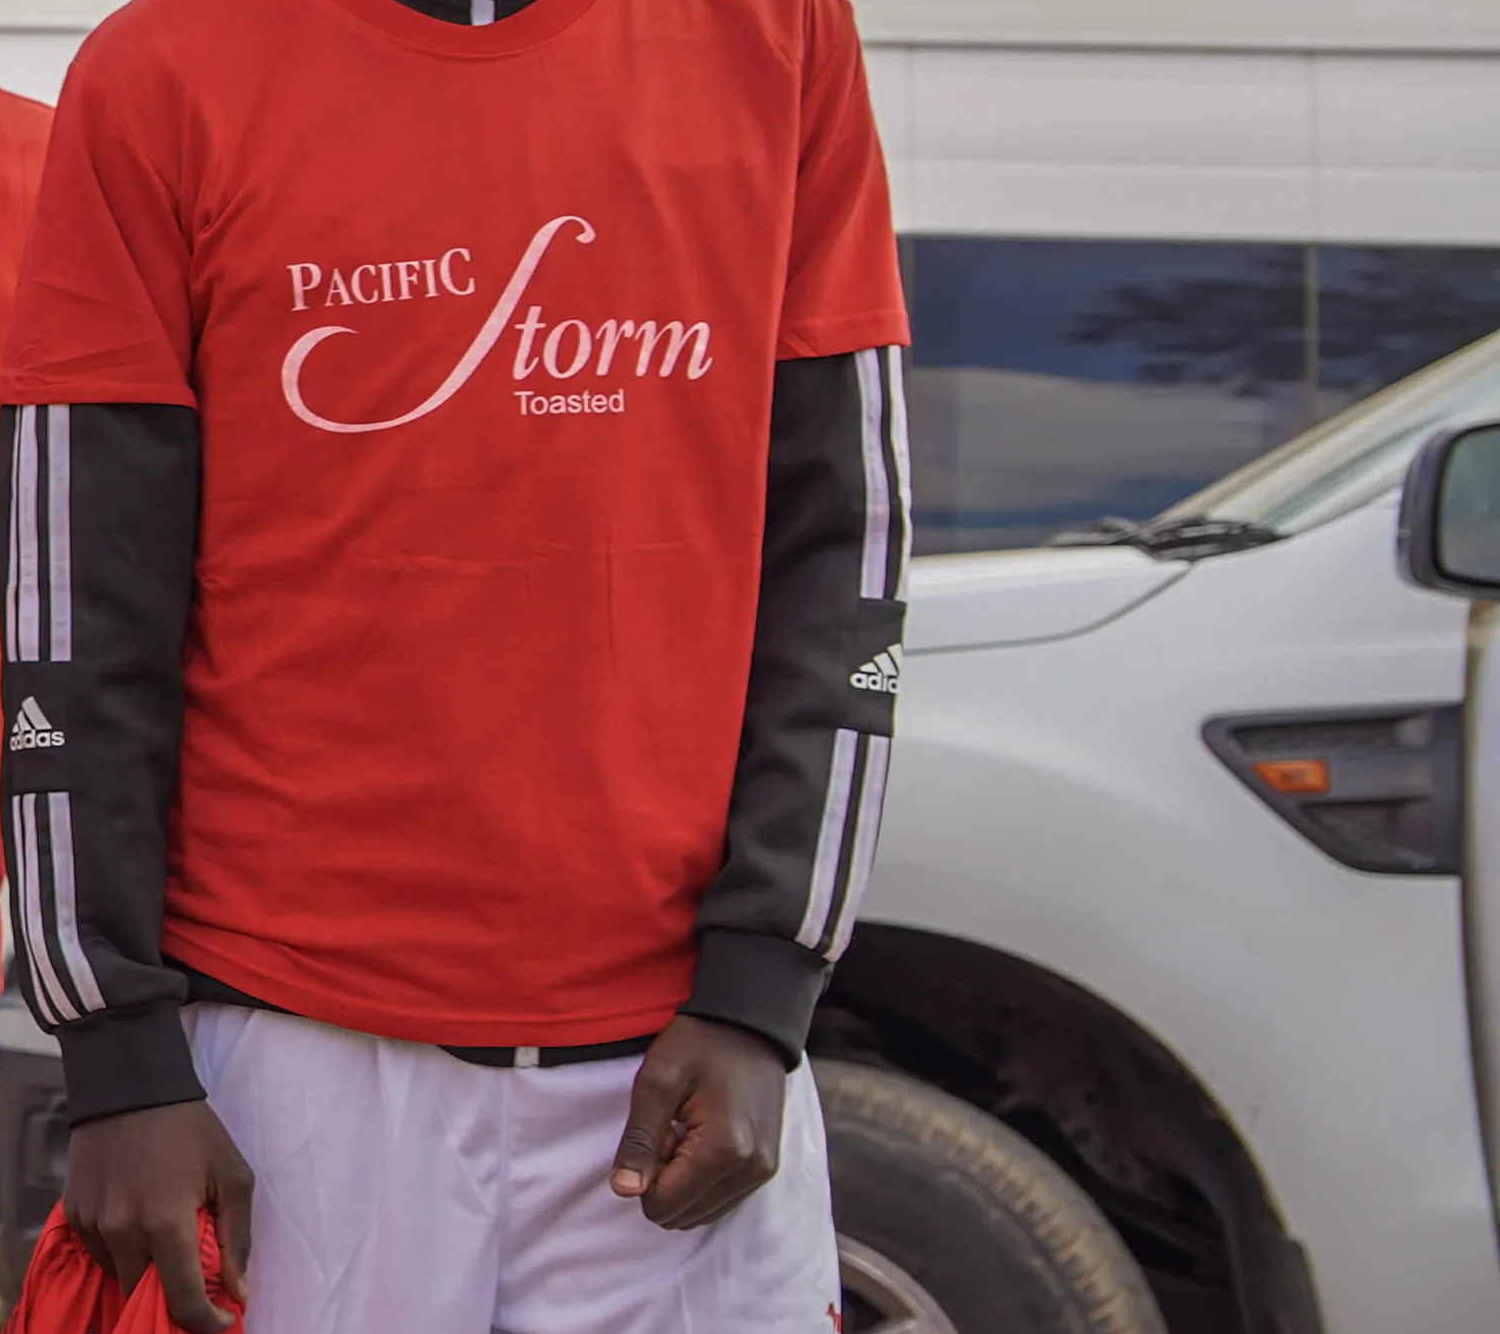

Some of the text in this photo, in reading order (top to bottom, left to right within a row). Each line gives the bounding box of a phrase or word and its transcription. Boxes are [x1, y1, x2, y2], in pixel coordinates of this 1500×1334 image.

[286, 247, 476, 311] PACIFIC
[281, 215, 713, 433] Storm
[513, 388, 625, 415] Toasted
[849, 671, 901, 695] adid
